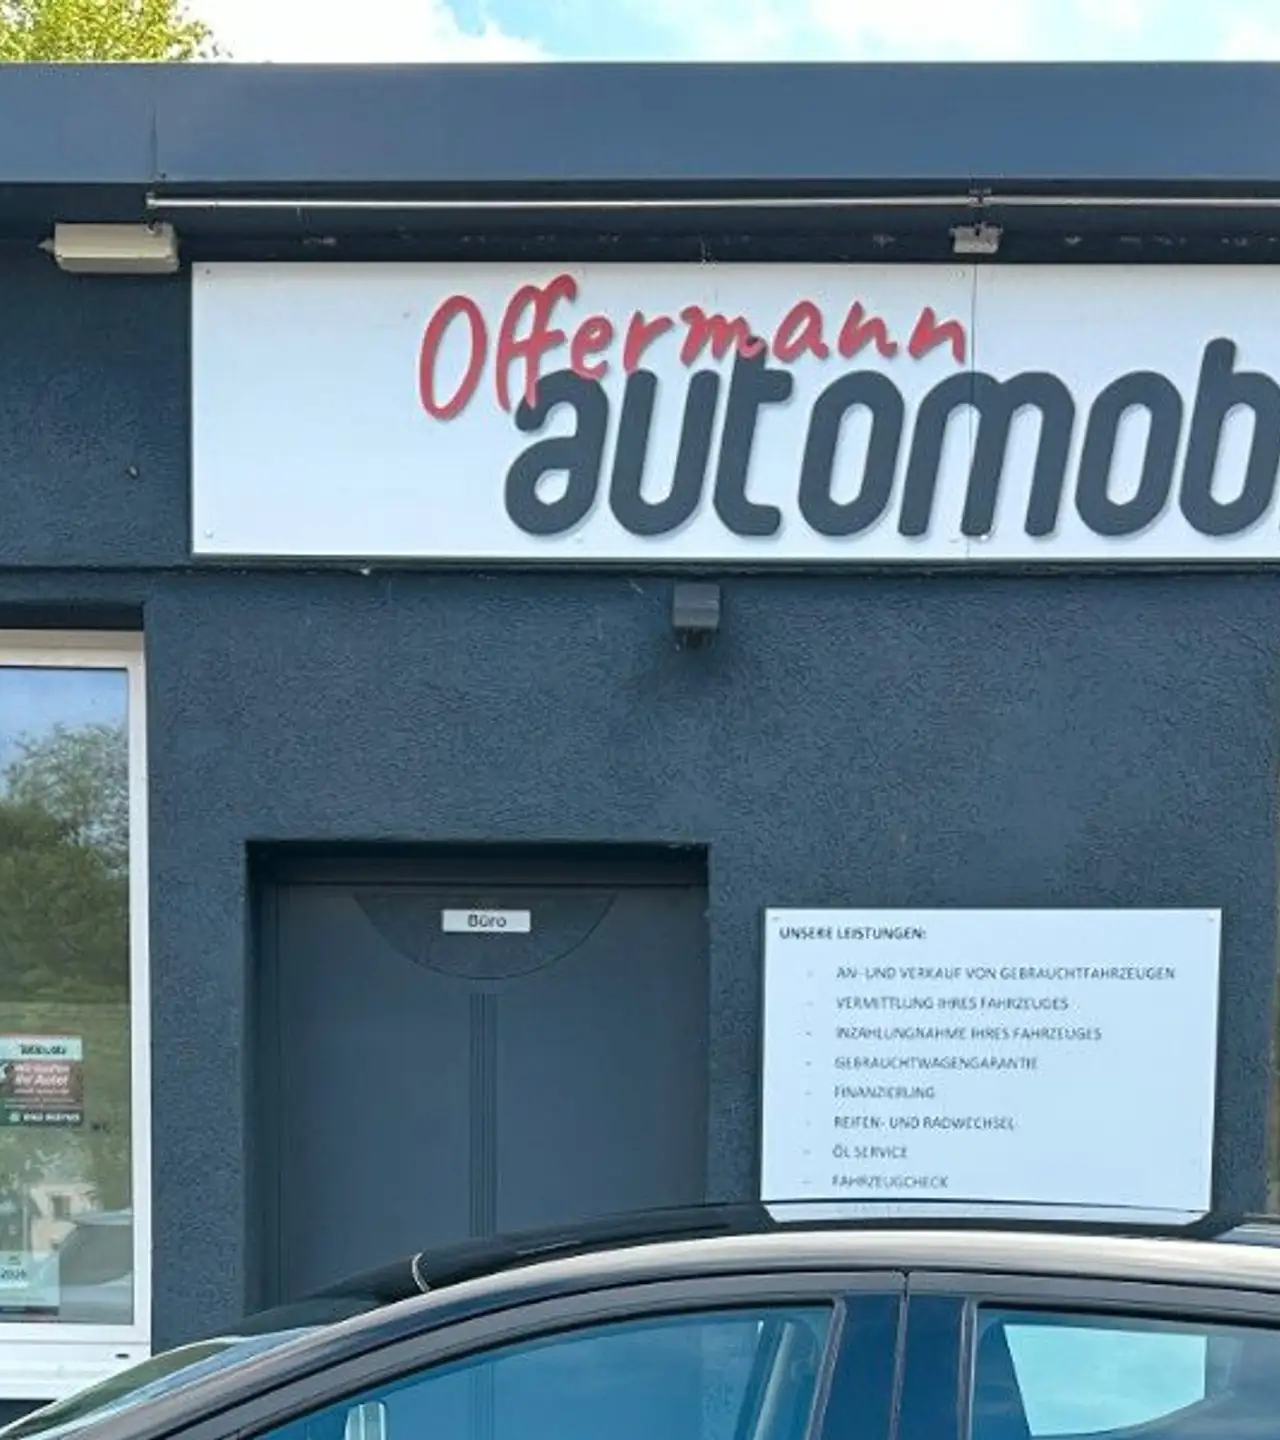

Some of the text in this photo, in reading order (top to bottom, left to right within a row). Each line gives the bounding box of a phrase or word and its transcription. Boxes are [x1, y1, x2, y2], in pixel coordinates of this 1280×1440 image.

[419, 273, 967, 421] Offermann
[778, 926, 927, 941] UNSERE LEISTUNGEN:
[865, 966, 897, 980] UND
[900, 966, 963, 980] VERKAUF
[966, 966, 997, 981] VON
[999, 966, 1177, 981] GEBRAUCHTFAHRZEUGEN
[836, 996, 1070, 1011] VERMITTLUNG IHRES FAHRZEUGES
[835, 1026, 1103, 1041] INZAHLUNGNAHME IHRES FAHRZEUGES
[833, 1056, 1038, 1070] GEBRAUCHTWAGENGARANTIE
[833, 1085, 936, 1100] FINANZIERUNG
[888, 1115, 921, 1130] UND
[922, 1115, 1015, 1131] RADWECHSEL
[854, 1145, 908, 1160] SERVICE
[831, 1174, 949, 1189] FAHRZEUGCHECK
